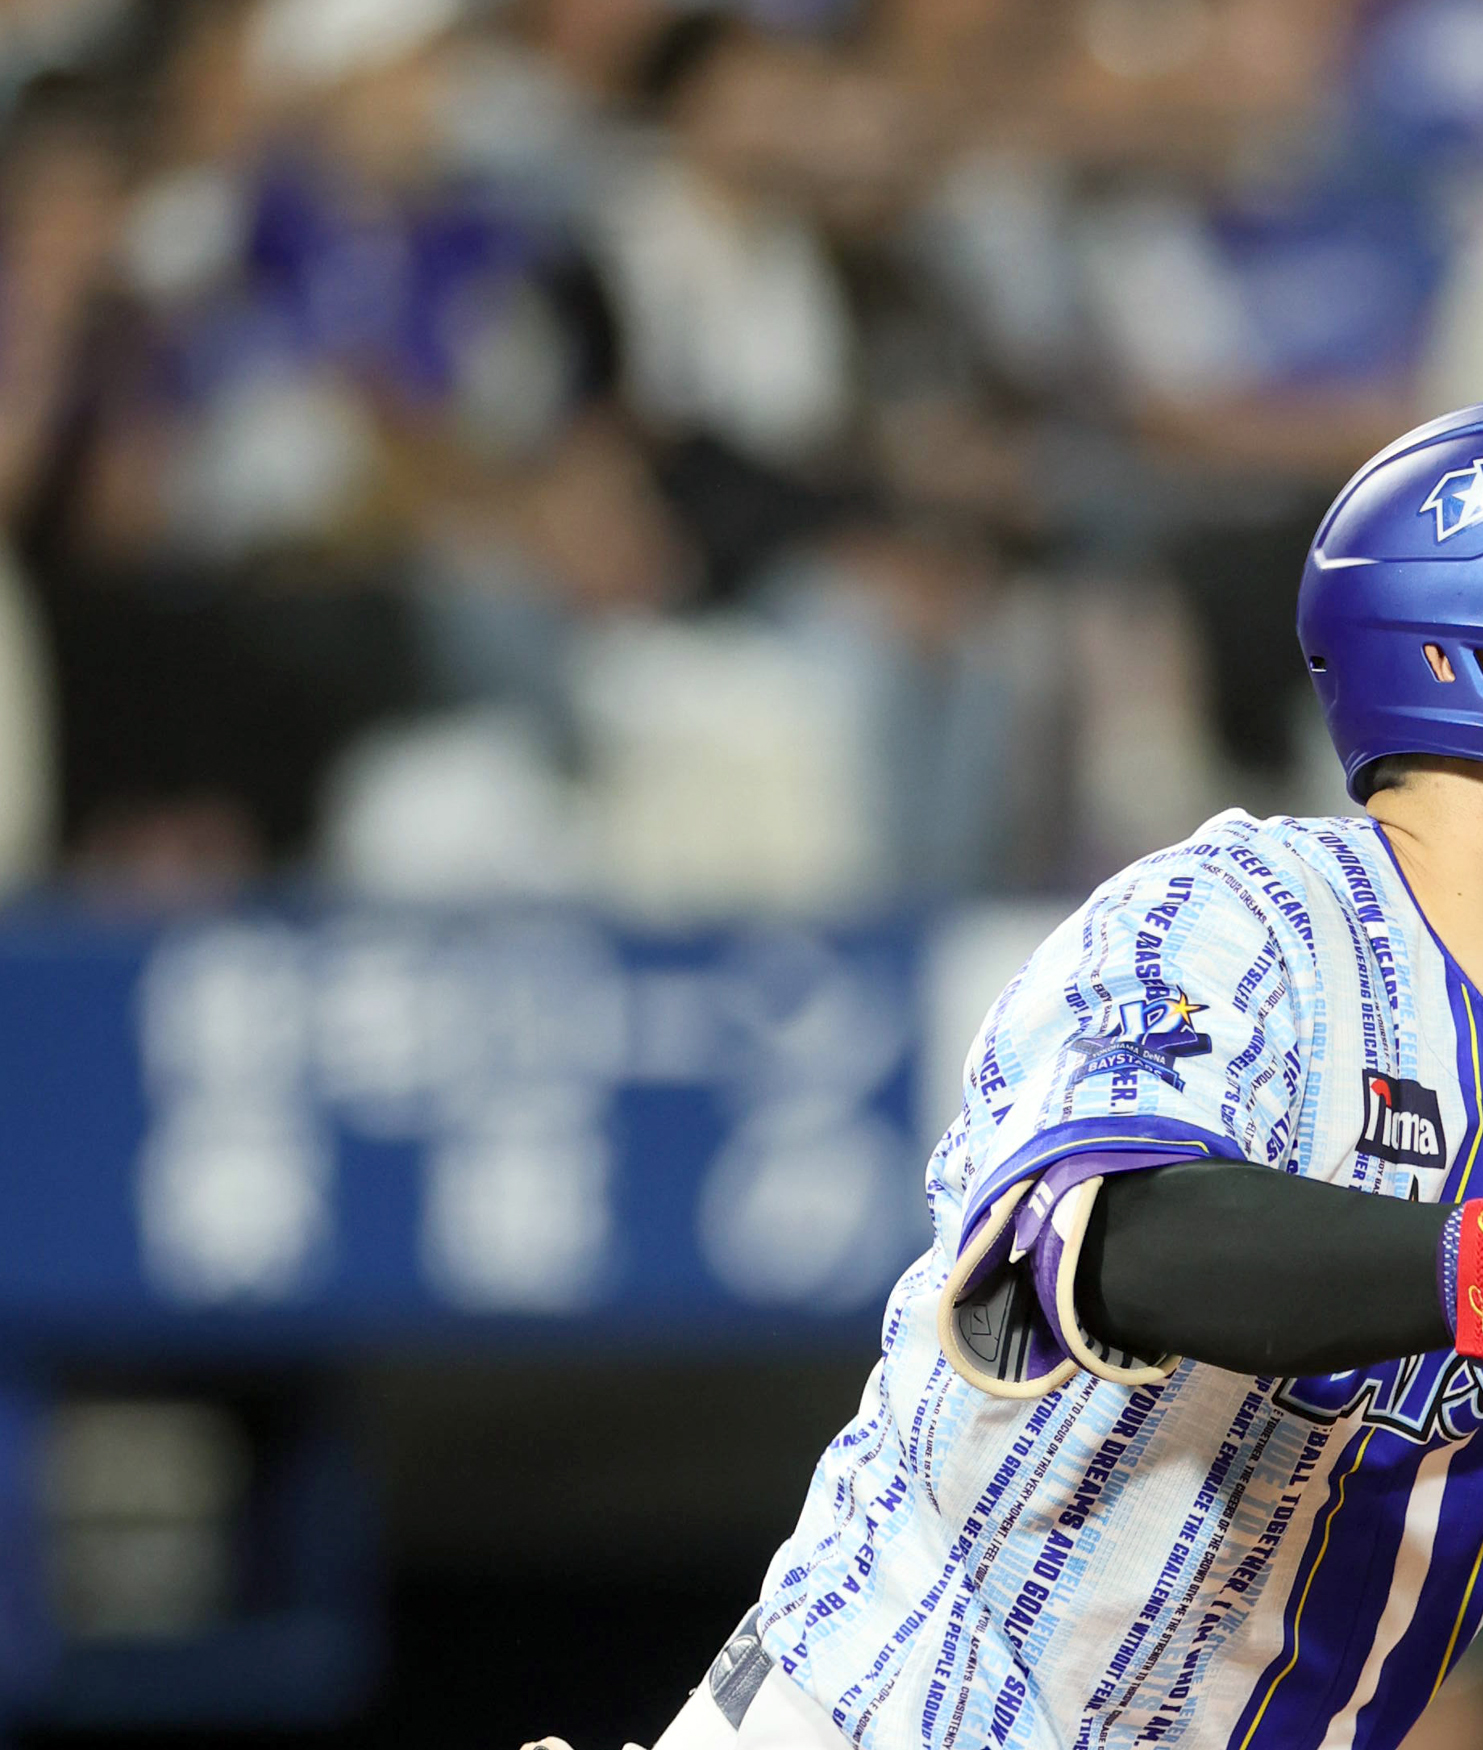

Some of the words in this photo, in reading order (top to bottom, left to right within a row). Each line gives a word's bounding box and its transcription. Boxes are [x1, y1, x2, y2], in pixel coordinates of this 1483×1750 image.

[1309, 831, 1385, 923] TOMORROW
[1221, 872, 1241, 893] YOUR
[1239, 889, 1267, 924] DREAMS.
[1135, 931, 1170, 1001] BASEB
[1064, 982, 1089, 1014] TOP!
[1092, 983, 1112, 1002] ENJOY
[1361, 1003, 1377, 1071] DEDICAT
[1142, 1050, 1166, 1064] DeNA
[1249, 1065, 1275, 1090] TODAY
[938, 1376, 952, 1394] AND
[1078, 1378, 1100, 1402] WANT
[1024, 1389, 1062, 1435] STONE
[1070, 1402, 1084, 1414] TO
[1111, 1383, 1165, 1438] YOUR
[1225, 1391, 1260, 1439] HEART.
[924, 1419, 936, 1457] FAILURE
[1052, 1413, 1076, 1443] FOCUS
[1118, 1408, 1167, 1468] THINGS
[1247, 1417, 1280, 1463] TOGETHER.
[855, 1426, 888, 1467] EVERYONE!
[1011, 1438, 1034, 1455] TO
[1045, 1442, 1059, 1456] ON
[923, 1460, 931, 1471] IS
[1032, 1457, 1051, 1477] THIS
[1193, 1441, 1237, 1511] EMBRACE
[1238, 1466, 1254, 1483] THE
[834, 1475, 844, 1510] THAT
[869, 1474, 906, 1513] AM.
[971, 1454, 1021, 1517] GROWTH.
[1018, 1479, 1038, 1501] VERY
[1058, 1437, 1125, 1530] DREAMS
[1089, 1468, 1130, 1526] DON'T
[1221, 1482, 1245, 1518] CHEERS
[962, 1517, 983, 1536] BE
[994, 1499, 1023, 1537] MOMENT.
[1178, 1517, 1203, 1541] THE
[1198, 1497, 1225, 1539] BUILDS
[1216, 1518, 1229, 1533] OF
[982, 1543, 999, 1561] FEEL
[1031, 1528, 1073, 1581] AND
[1074, 1524, 1102, 1554] GO
[1206, 1534, 1223, 1552] THE
[1218, 1493, 1301, 1595] TOGETHER.
[841, 1574, 860, 1594] A
[1138, 1542, 1189, 1622] CHALLENGE
[1167, 1538, 1205, 1601] CHARACTER.
[1192, 1550, 1215, 1584] CROWD
[949, 1593, 969, 1621] THE
[1174, 1602, 1188, 1617] ME
[1181, 1582, 1199, 1603] GIVE
[1209, 1600, 1230, 1611] I
[891, 1609, 927, 1645] YOUR
[1147, 1607, 1173, 1638] WHERE
[1165, 1616, 1181, 1633] THE
[1191, 1610, 1220, 1643] AM
[860, 1643, 896, 1683] 100%.
[934, 1621, 960, 1678] PEOPLE
[1104, 1625, 1150, 1680] WITHOUT
[1142, 1632, 1171, 1672] STRENGTH
[1134, 1671, 1148, 1682] TO
[1167, 1649, 1199, 1701] WHO
[837, 1684, 862, 1706] ALL
[920, 1678, 946, 1740] AROUND
[985, 1674, 1028, 1746] SHOW.
[1083, 1679, 1115, 1711] FEAR.
[1116, 1682, 1141, 1709] THROW.
[941, 1685, 969, 1750] CONSISTENCY
[1096, 1709, 1121, 1744] COURAGE
[1133, 1715, 1171, 1745] AM.
